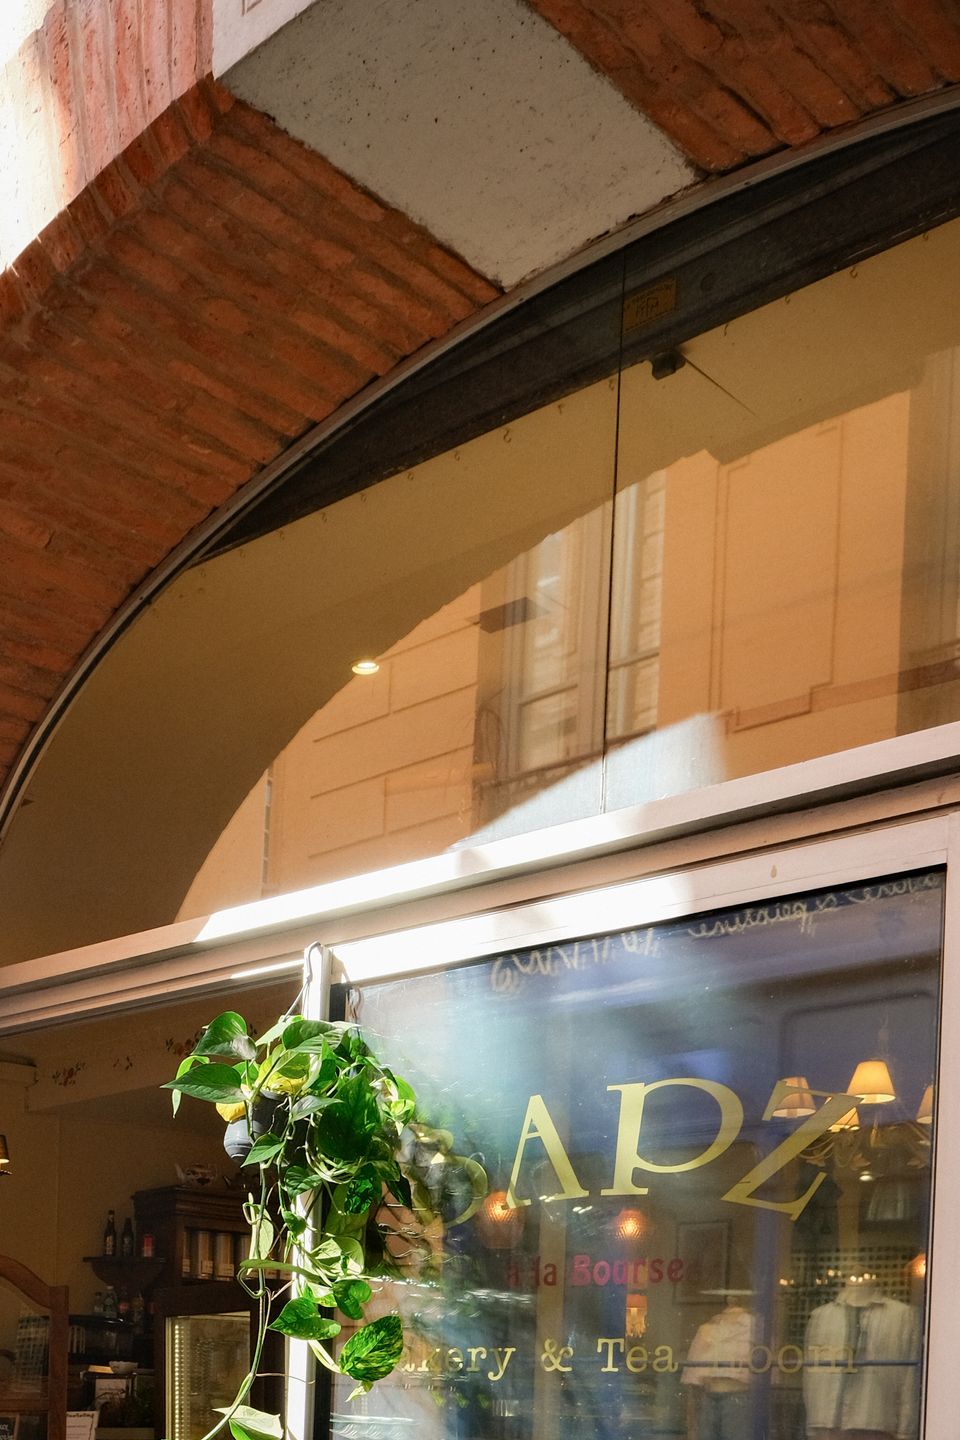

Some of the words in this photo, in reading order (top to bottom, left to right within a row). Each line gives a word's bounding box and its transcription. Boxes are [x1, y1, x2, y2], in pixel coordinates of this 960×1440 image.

[570, 1254, 684, 1287] Bourse
[540, 1338, 573, 1373] &
[597, 1337, 680, 1375] Tea
